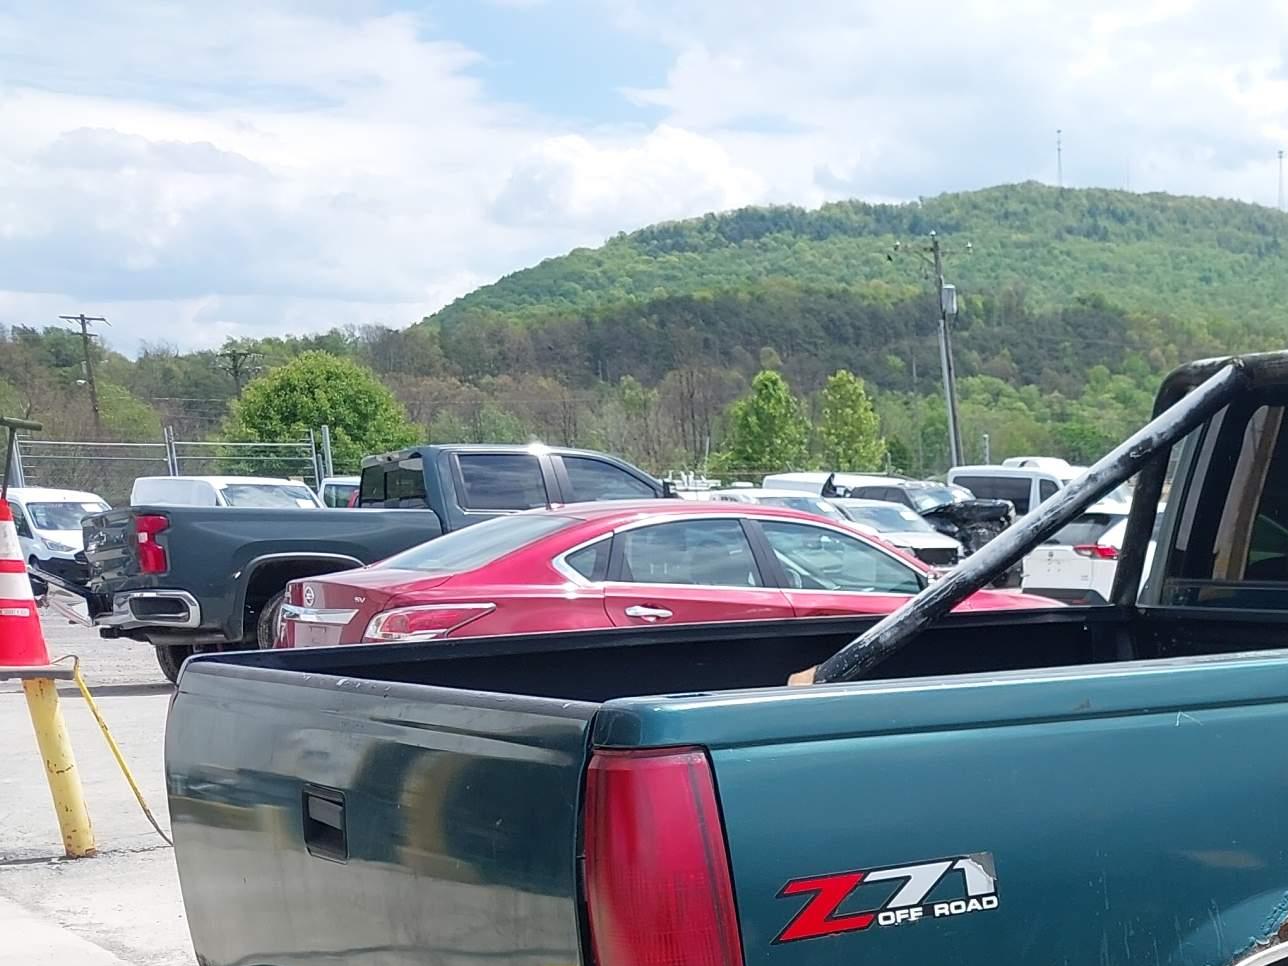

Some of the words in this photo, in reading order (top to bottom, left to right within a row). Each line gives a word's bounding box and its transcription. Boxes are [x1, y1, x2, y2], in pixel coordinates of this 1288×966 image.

[771, 855, 997, 944] Z71
[877, 905, 924, 926] OFF
[934, 895, 999, 917] ROAD
